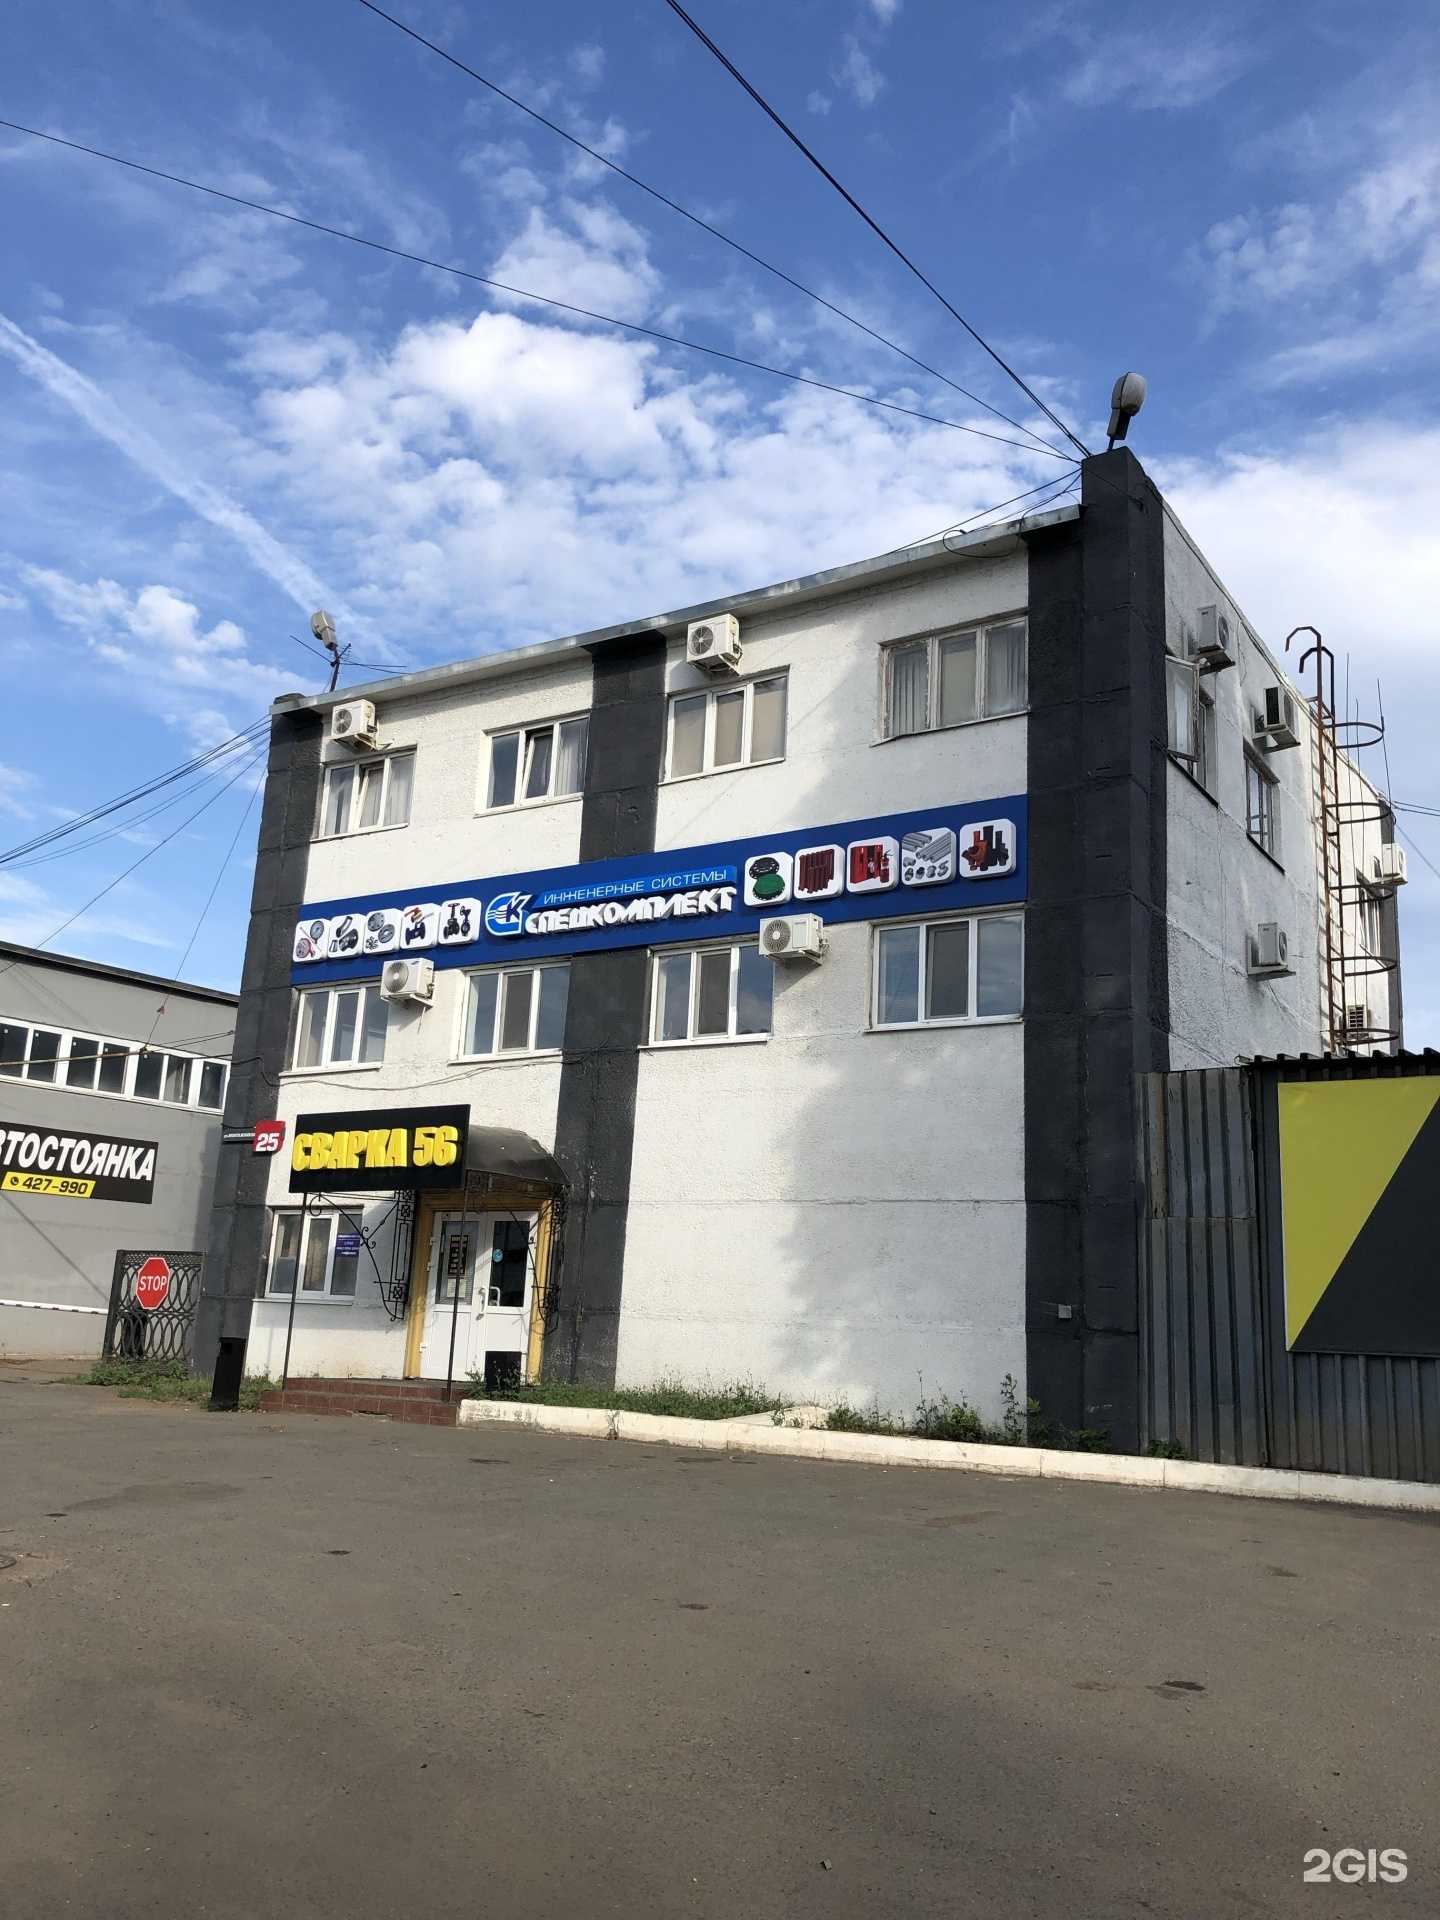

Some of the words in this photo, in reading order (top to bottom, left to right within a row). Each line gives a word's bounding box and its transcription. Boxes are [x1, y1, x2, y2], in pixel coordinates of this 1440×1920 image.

[544, 880, 644, 904] ИНЖЕНЕРНЫЕ
[651, 869, 727, 889] СИСТЕМЫ
[525, 886, 737, 934] СПЕЦКОМПЛЕКТ
[256, 1132, 280, 1152] 25
[292, 1127, 407, 1171] СВАРКА
[413, 1126, 458, 1167] 56
[22, 1176, 88, 1195] 427-990
[139, 1275, 168, 1292] STOP
